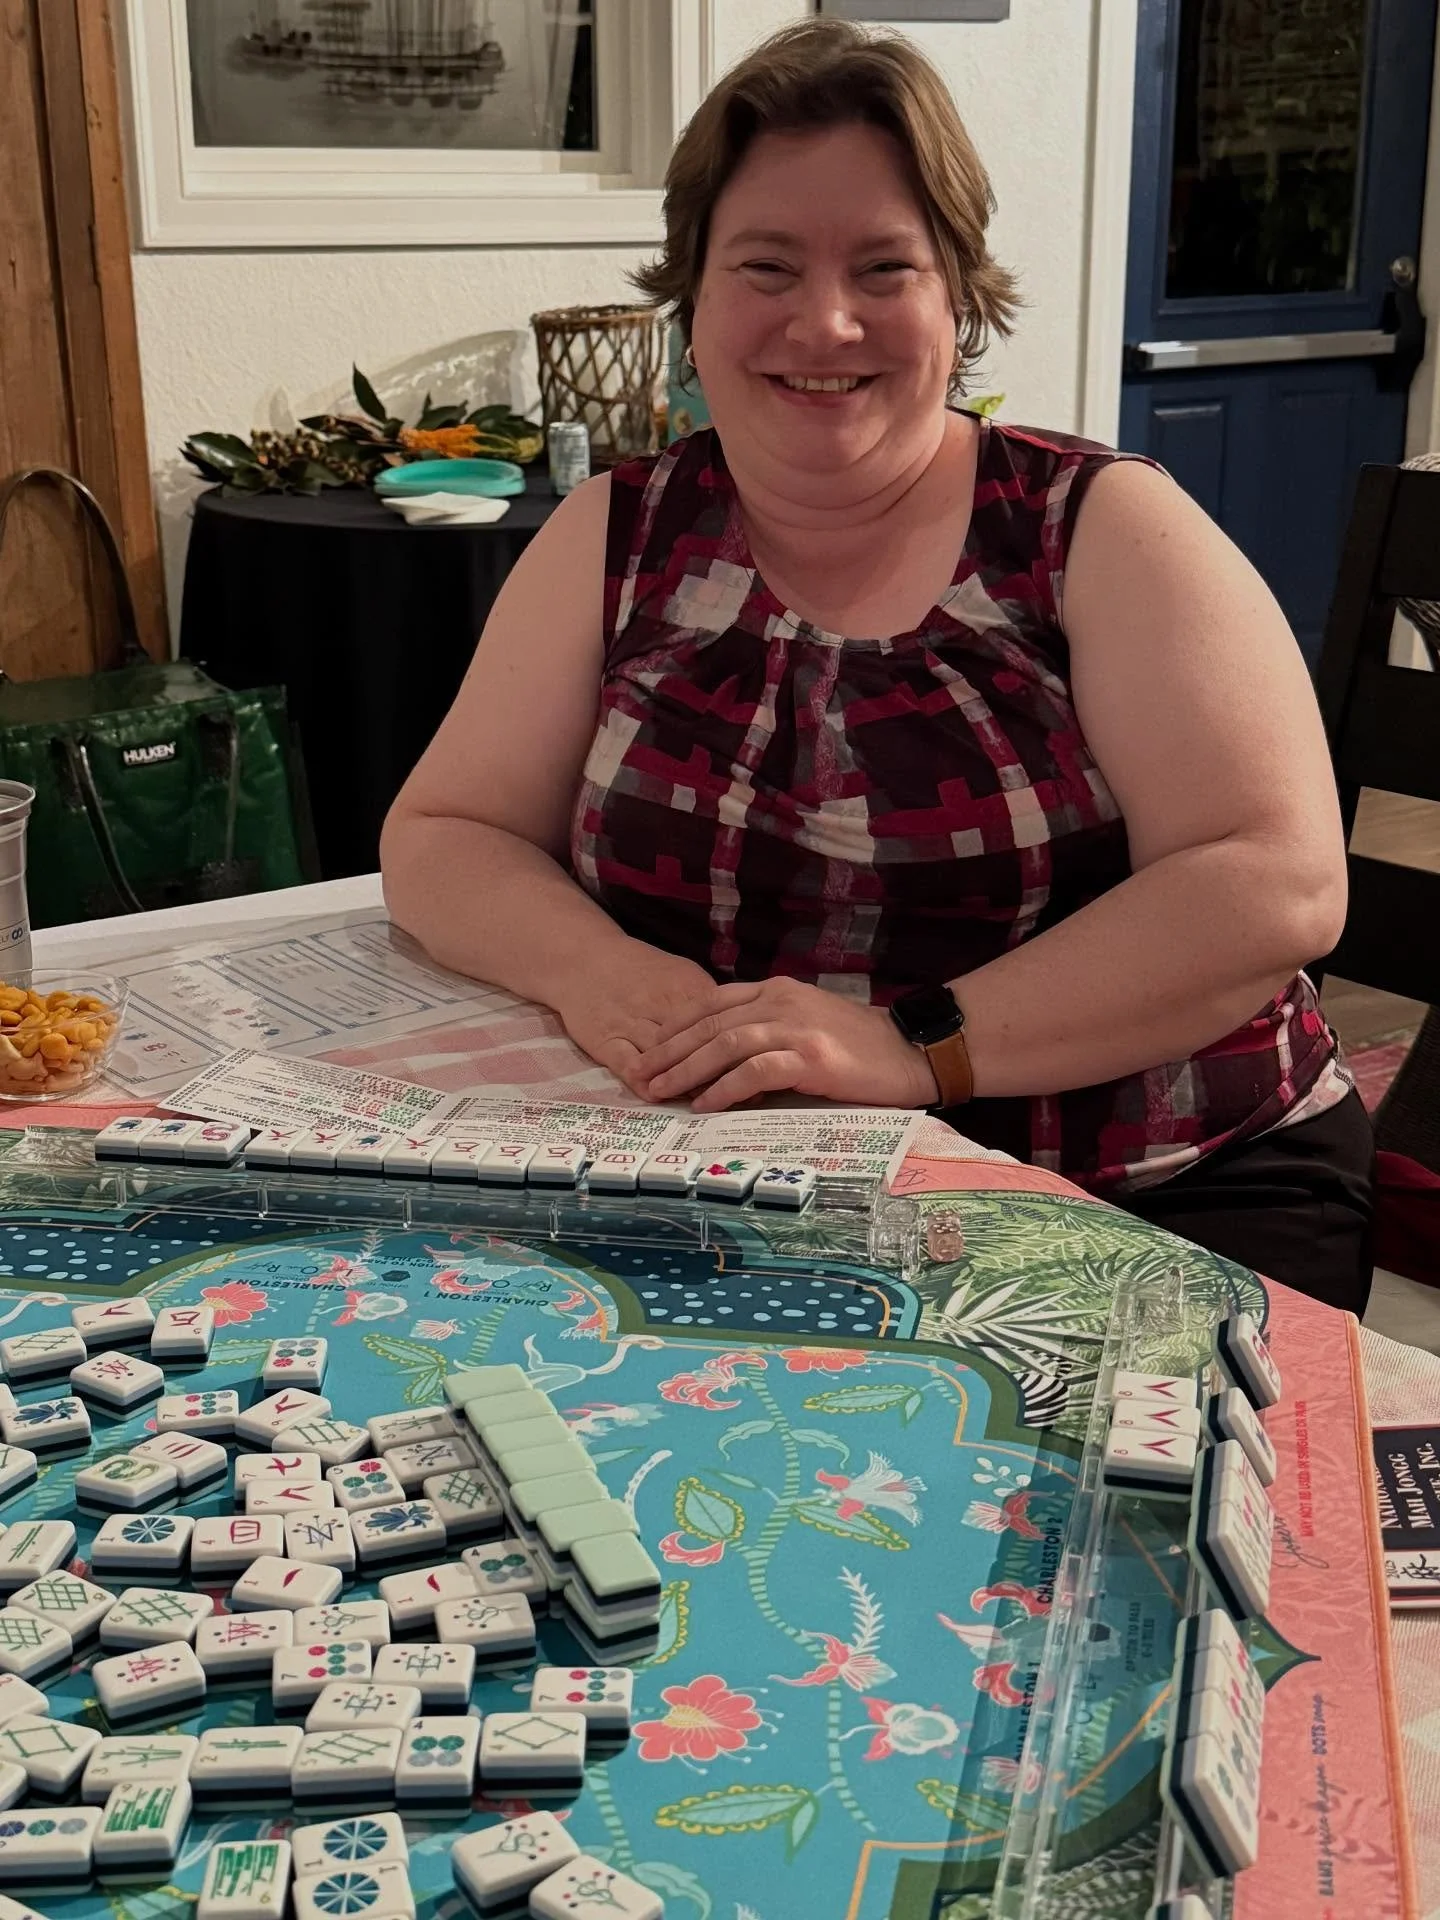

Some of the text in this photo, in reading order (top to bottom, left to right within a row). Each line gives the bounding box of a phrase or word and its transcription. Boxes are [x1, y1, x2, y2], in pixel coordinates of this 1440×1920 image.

[122, 743, 176, 766] HULKEN
[237, 1279, 347, 1292] CHARLESTON
[430, 1291, 550, 1308] CHARLESTON
[1297, 1428, 1310, 1459] SINGLES
[1298, 1471, 1311, 1490] USED
[1388, 1452, 1424, 1496] JONGG
[1299, 1503, 1313, 1519] NOT
[1405, 1498, 1435, 1529] MAH
[1037, 1516, 1063, 1604] CHARLESTON 2
[413, 1719, 425, 1731] 4
[1311, 1725, 1327, 1756] DOTS
